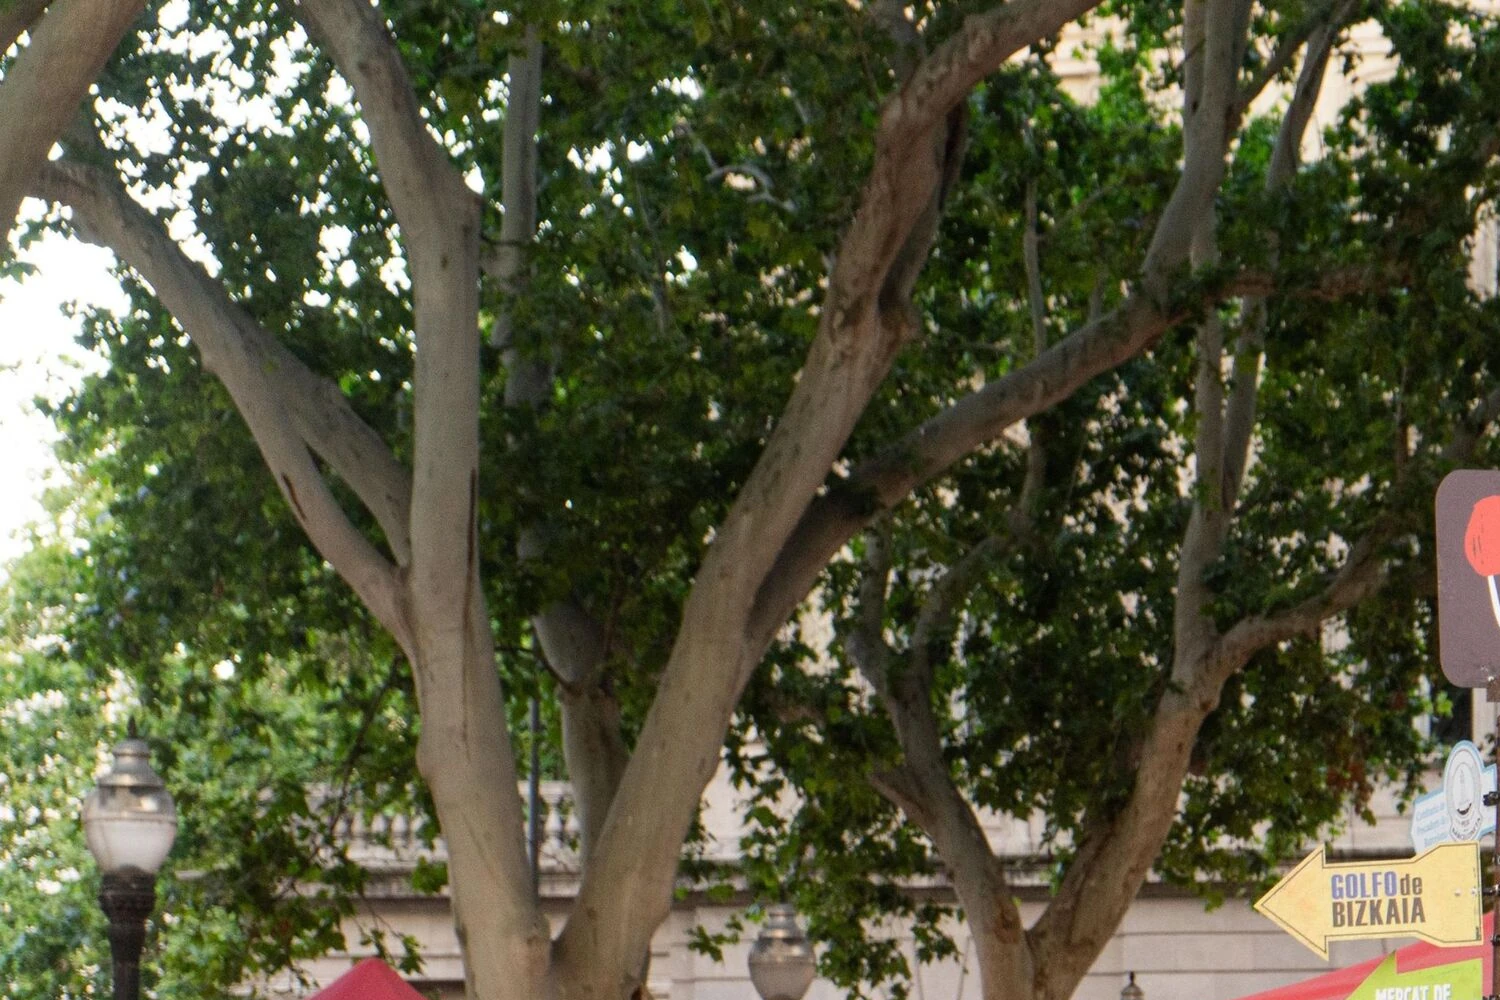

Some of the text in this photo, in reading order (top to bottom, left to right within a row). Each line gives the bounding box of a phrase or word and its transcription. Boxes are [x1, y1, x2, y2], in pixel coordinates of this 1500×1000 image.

[1331, 871, 1423, 900] GOLFO de
[1332, 897, 1426, 928] BIZKAIA
